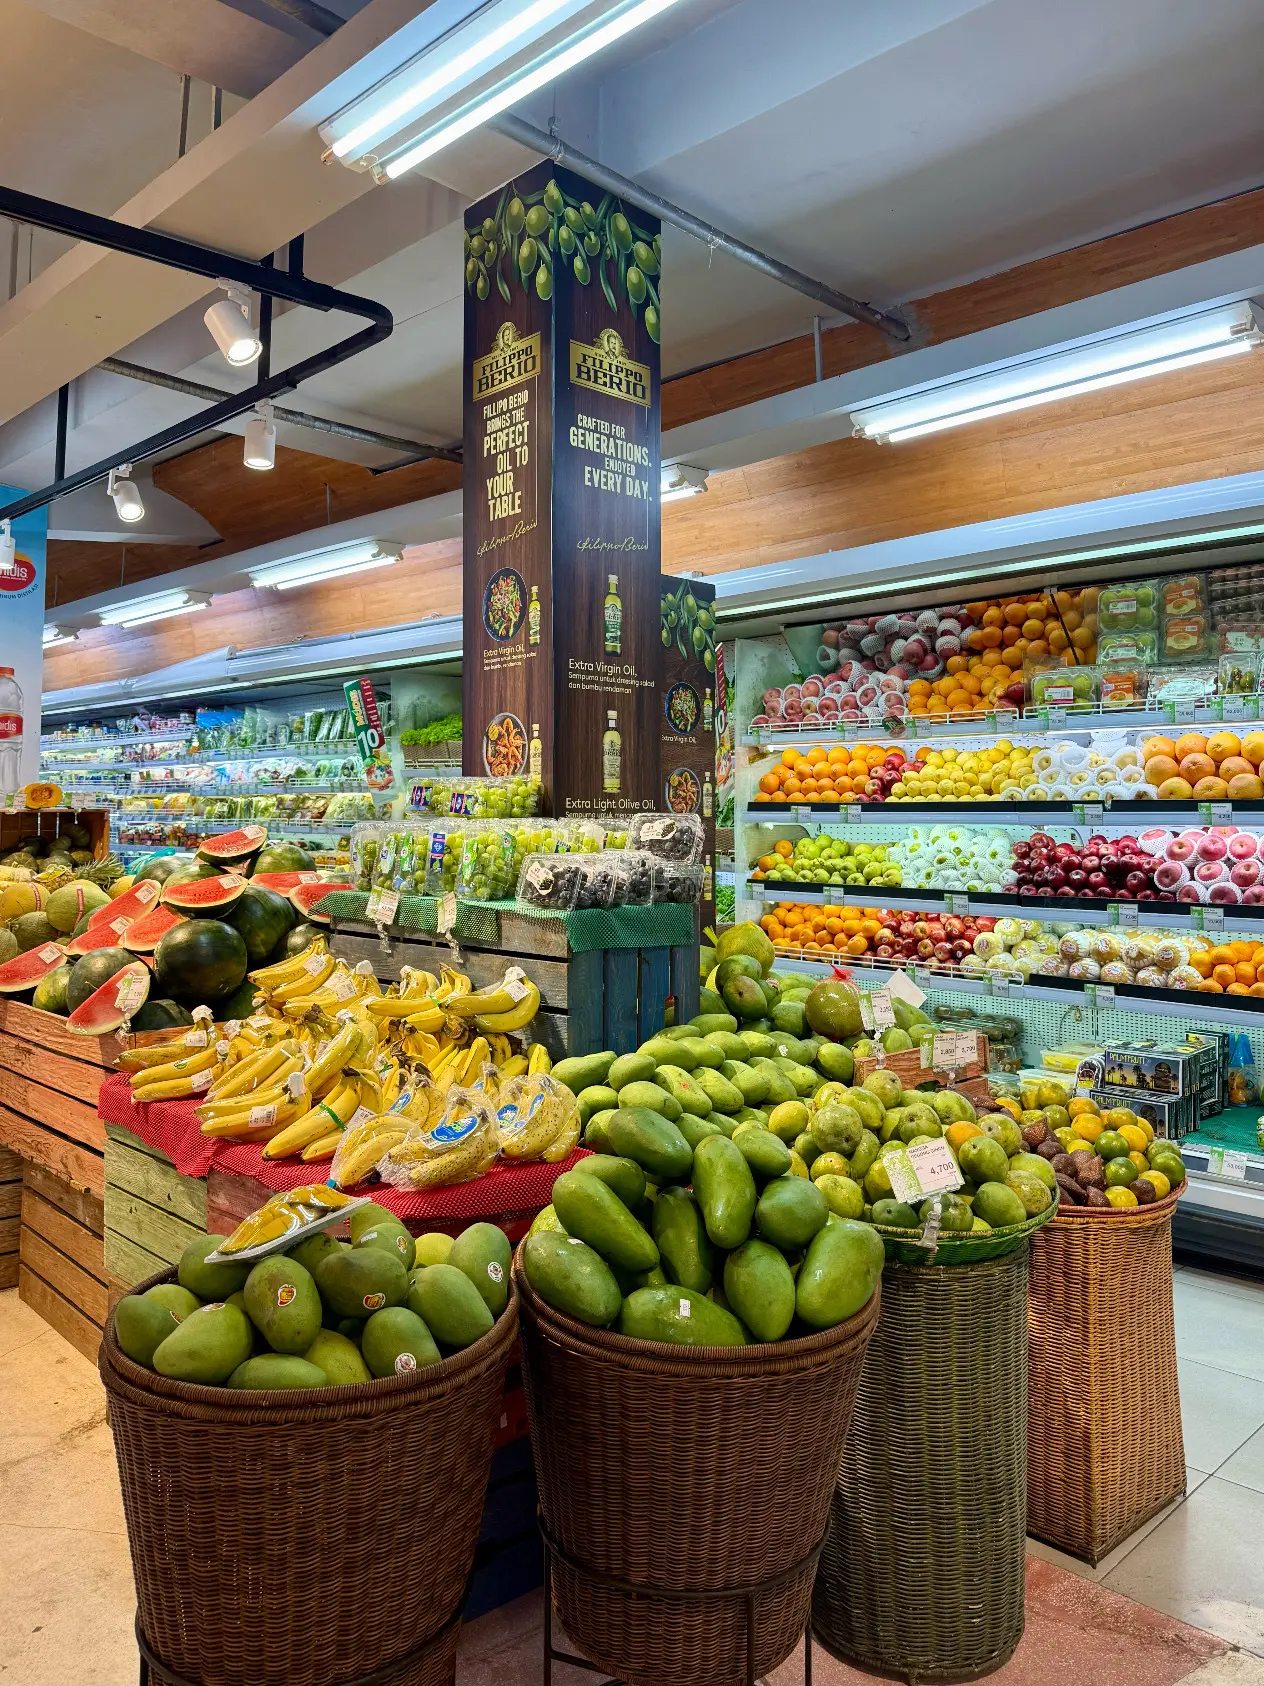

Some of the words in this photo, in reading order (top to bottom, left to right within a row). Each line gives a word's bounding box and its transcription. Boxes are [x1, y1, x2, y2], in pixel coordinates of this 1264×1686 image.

[477, 354, 536, 394] BERIO
[482, 344, 532, 376] FILIPPO
[580, 352, 643, 382] FILIPPO
[576, 362, 646, 400] BERIO
[508, 389, 529, 409] BERIO
[486, 412, 510, 434] BRINGS
[512, 407, 525, 424] THE
[577, 414, 610, 434] CRAFTED
[611, 424, 625, 439] FOR
[484, 420, 530, 458] PERFECT
[569, 426, 652, 467] GENERATIONS.
[497, 451, 512, 474] OIL
[515, 445, 529, 467] TO
[604, 457, 636, 477] ENJOYED
[486, 471, 514, 500] YOUR
[584, 465, 622, 494] EVERY
[626, 476, 652, 501] DAY.
[488, 490, 522, 522] TABLE
[483, 649, 498, 658] Extra
[498, 645, 515, 655] Virgin
[568, 658, 594, 671] Extra
[595, 661, 621, 676] Virgin
[623, 664, 638, 678] Oil,
[581, 683, 602, 691] bumbu
[603, 685, 632, 694] rendaman
[358, 728, 379, 758] 10
[565, 798, 591, 808] Extra
[594, 798, 617, 811] Light
[618, 799, 640, 809] Olive
[642, 799, 656, 810] Oil,
[930, 1161, 954, 1176] 4,700
